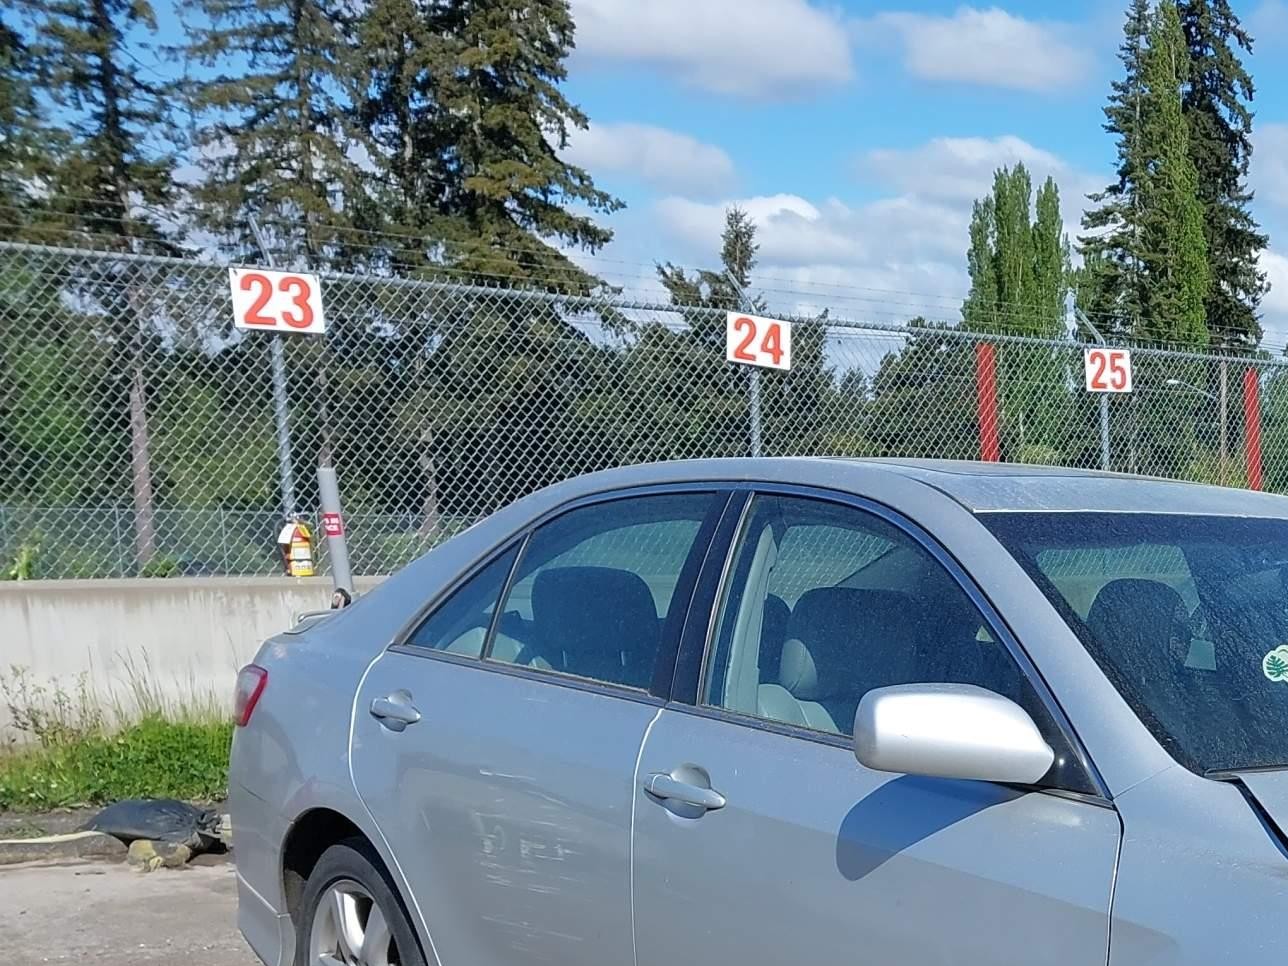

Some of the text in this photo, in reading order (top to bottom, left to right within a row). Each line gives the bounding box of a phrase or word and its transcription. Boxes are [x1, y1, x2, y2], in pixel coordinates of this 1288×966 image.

[240, 273, 314, 329] 23
[732, 317, 785, 365] 24
[1088, 351, 1127, 390] 25
